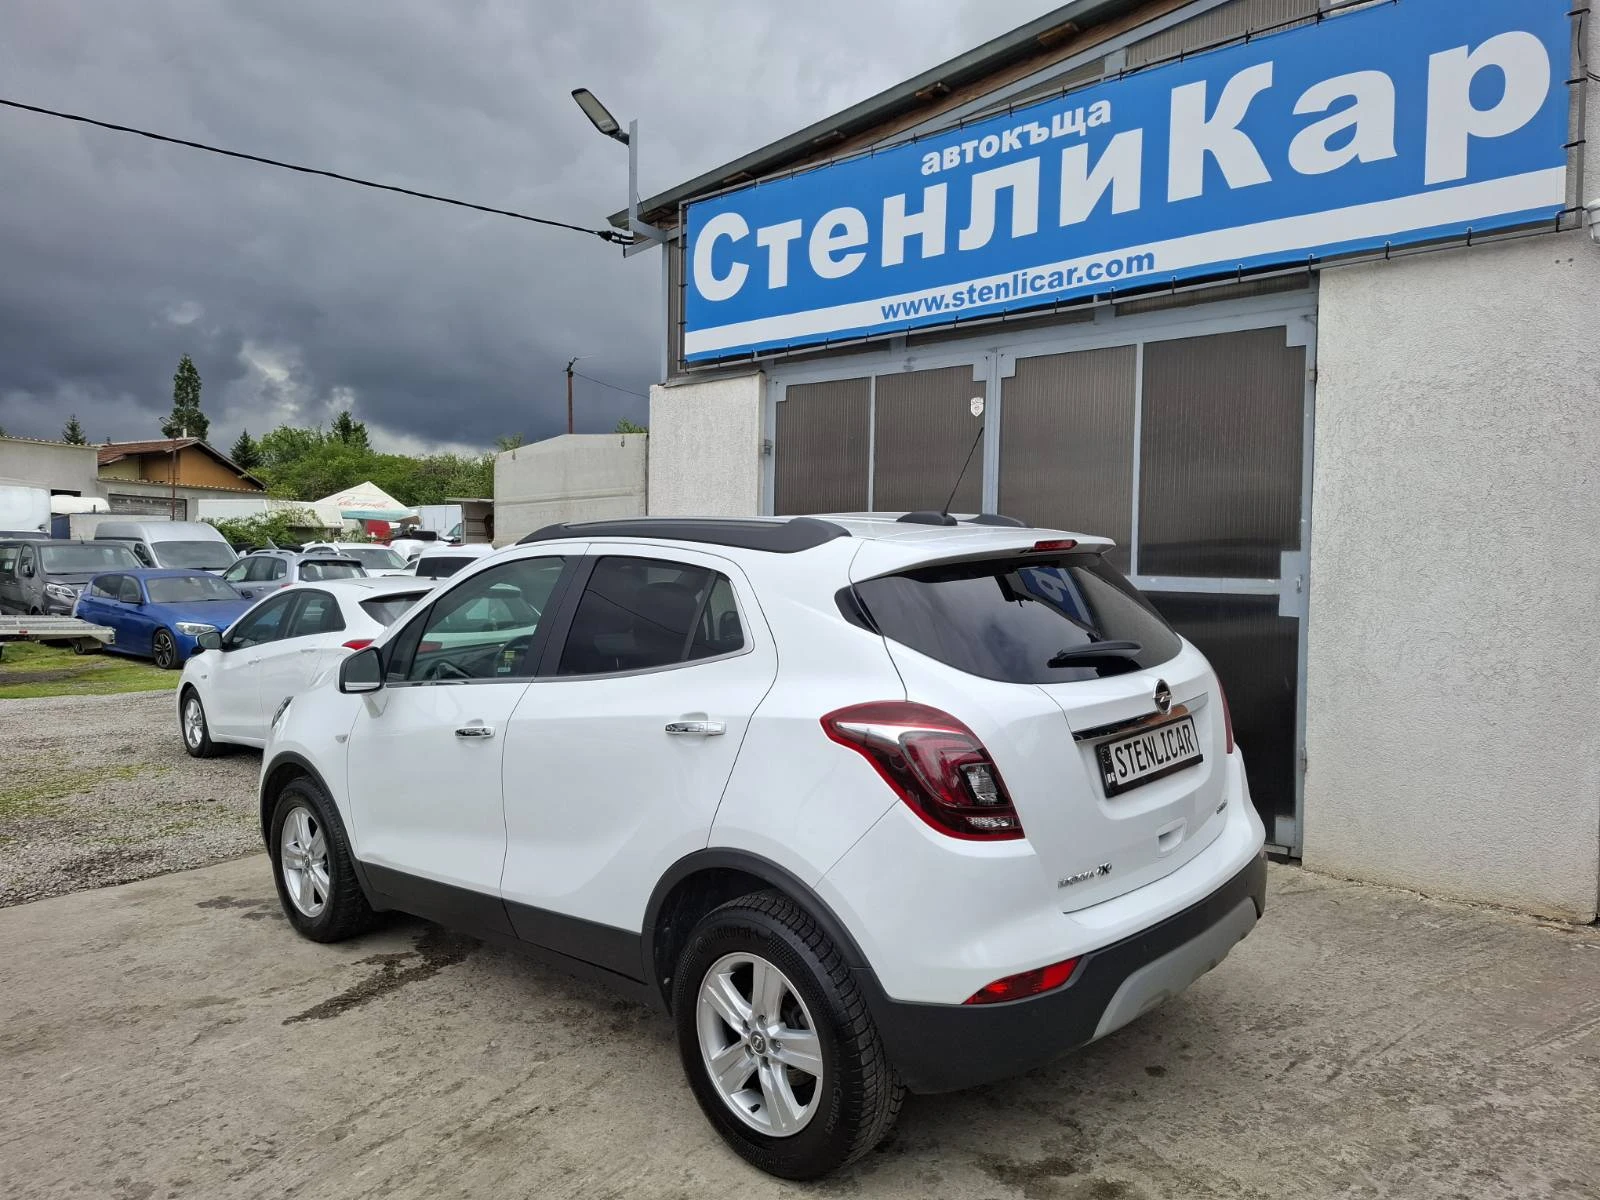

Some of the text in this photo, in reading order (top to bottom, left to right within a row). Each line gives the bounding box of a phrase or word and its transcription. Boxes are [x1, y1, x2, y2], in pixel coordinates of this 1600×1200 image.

[921, 100, 1111, 176] автокъща
[881, 252, 1155, 321] www.stenlicar.com
[1114, 724, 1195, 779] STENLICAR
